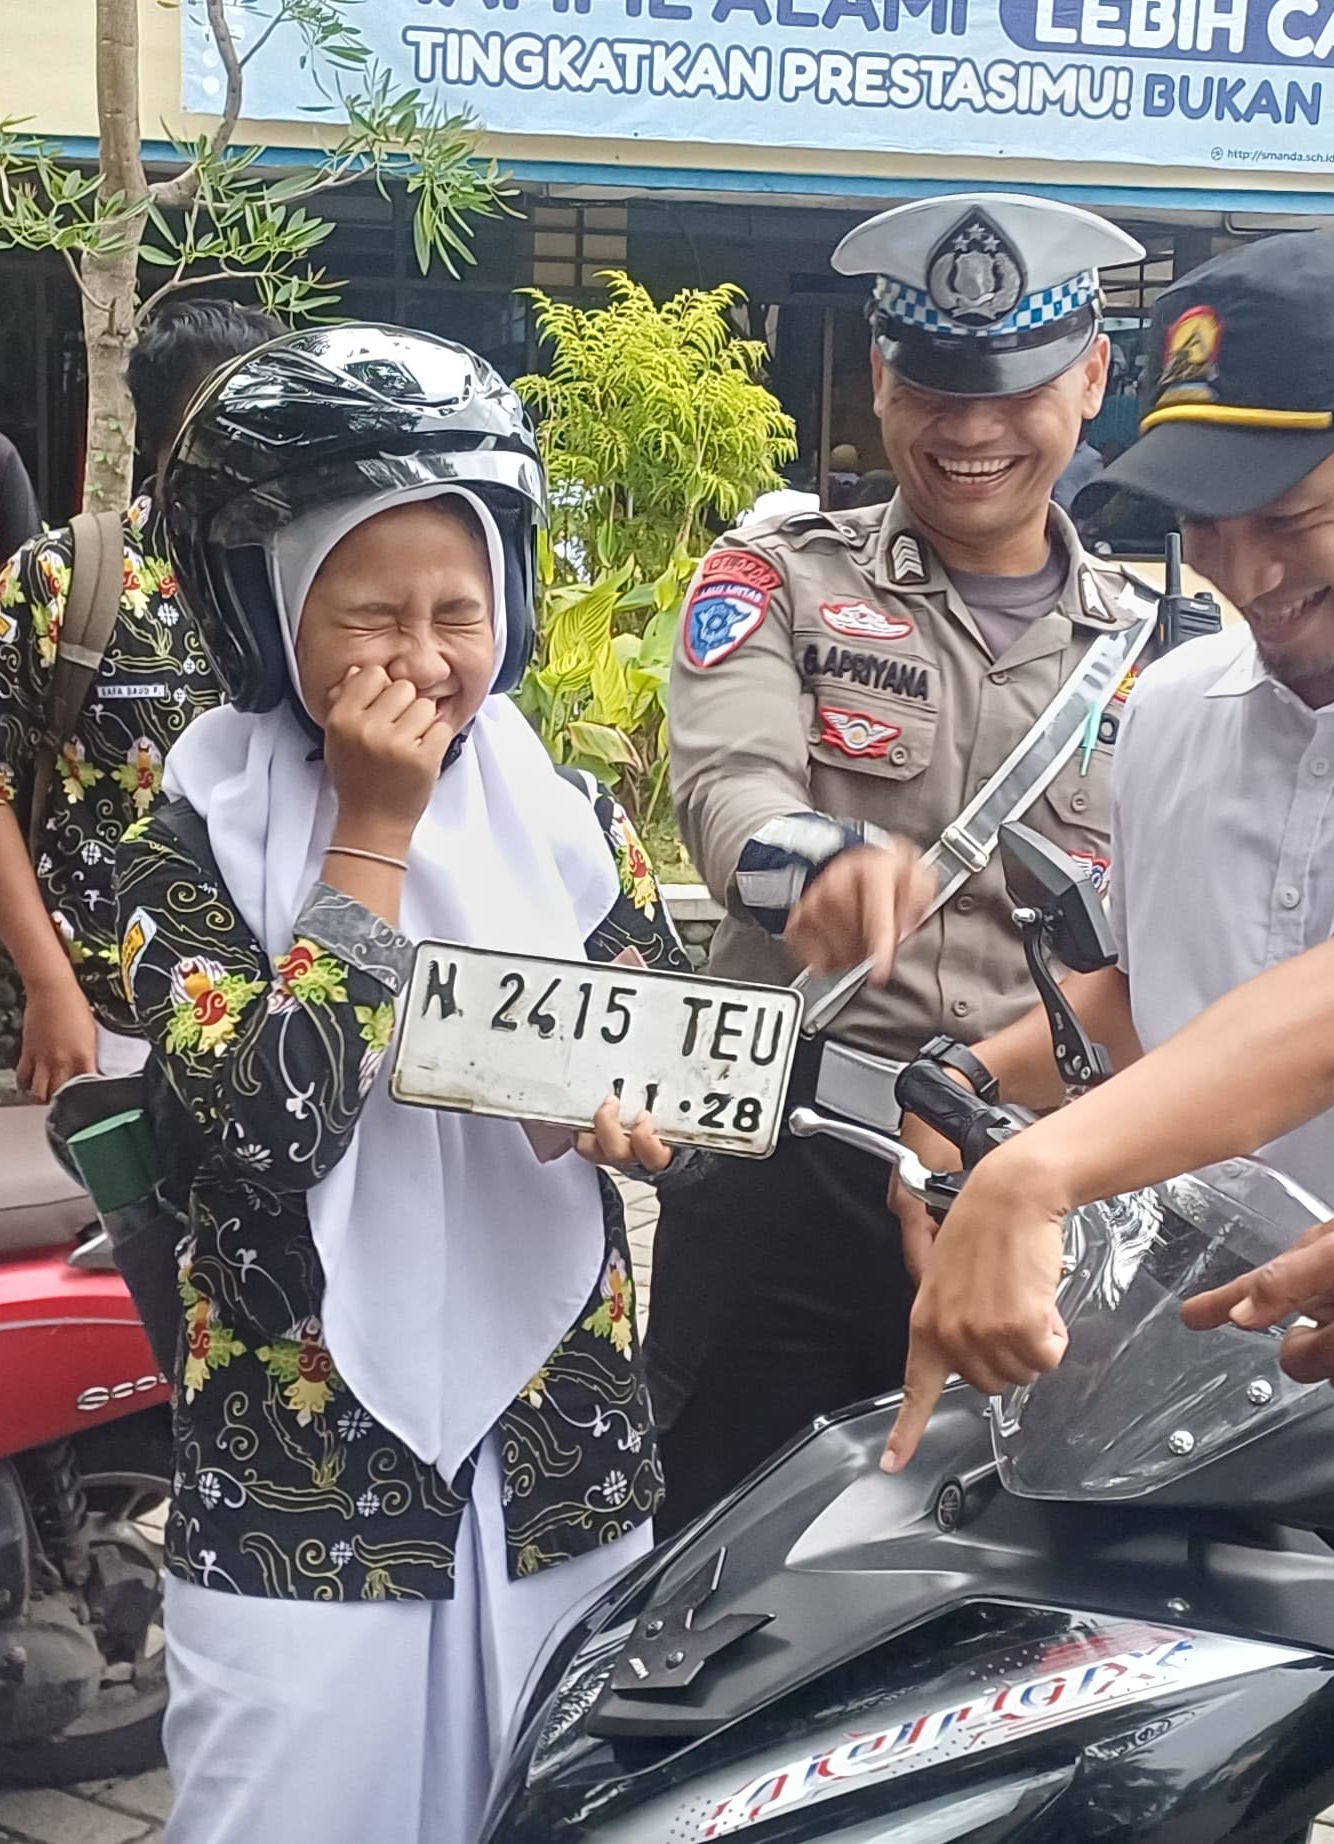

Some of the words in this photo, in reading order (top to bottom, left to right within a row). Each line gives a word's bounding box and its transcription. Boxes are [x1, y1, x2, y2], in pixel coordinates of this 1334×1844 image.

[402, 25, 771, 101] TINGKATKAN
[780, 47, 1133, 119] PRESTASIMU!
[1143, 72, 1322, 126] BUKAN
[1035, 0, 1248, 54] LEBIH
[422, 960, 459, 1019] N
[491, 973, 637, 1045] 2415
[681, 996, 784, 1066] TEU
